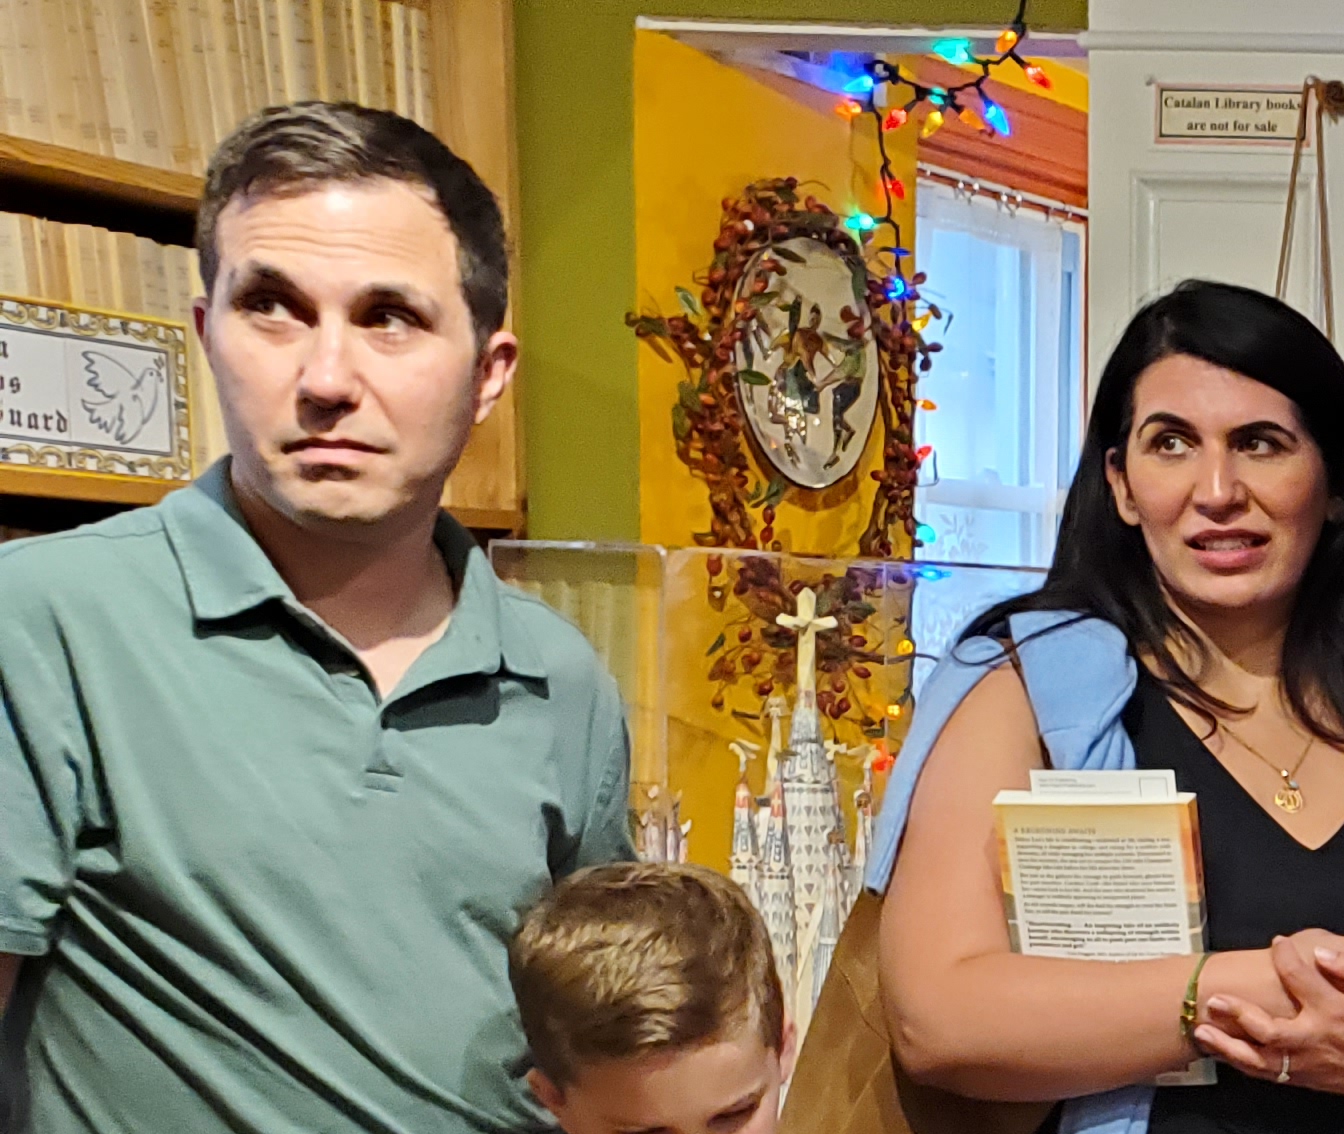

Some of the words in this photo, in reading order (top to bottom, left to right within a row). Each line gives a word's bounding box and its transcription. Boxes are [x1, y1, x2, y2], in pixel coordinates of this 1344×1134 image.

[1164, 97, 1211, 109] Catalan
[1215, 97, 1261, 112] Library
[1187, 121, 1206, 131] are
[1210, 121, 1229, 131] not
[1233, 120, 1249, 131] for
[1254, 120, 1277, 132] sale
[0, 408, 68, 433] uard
